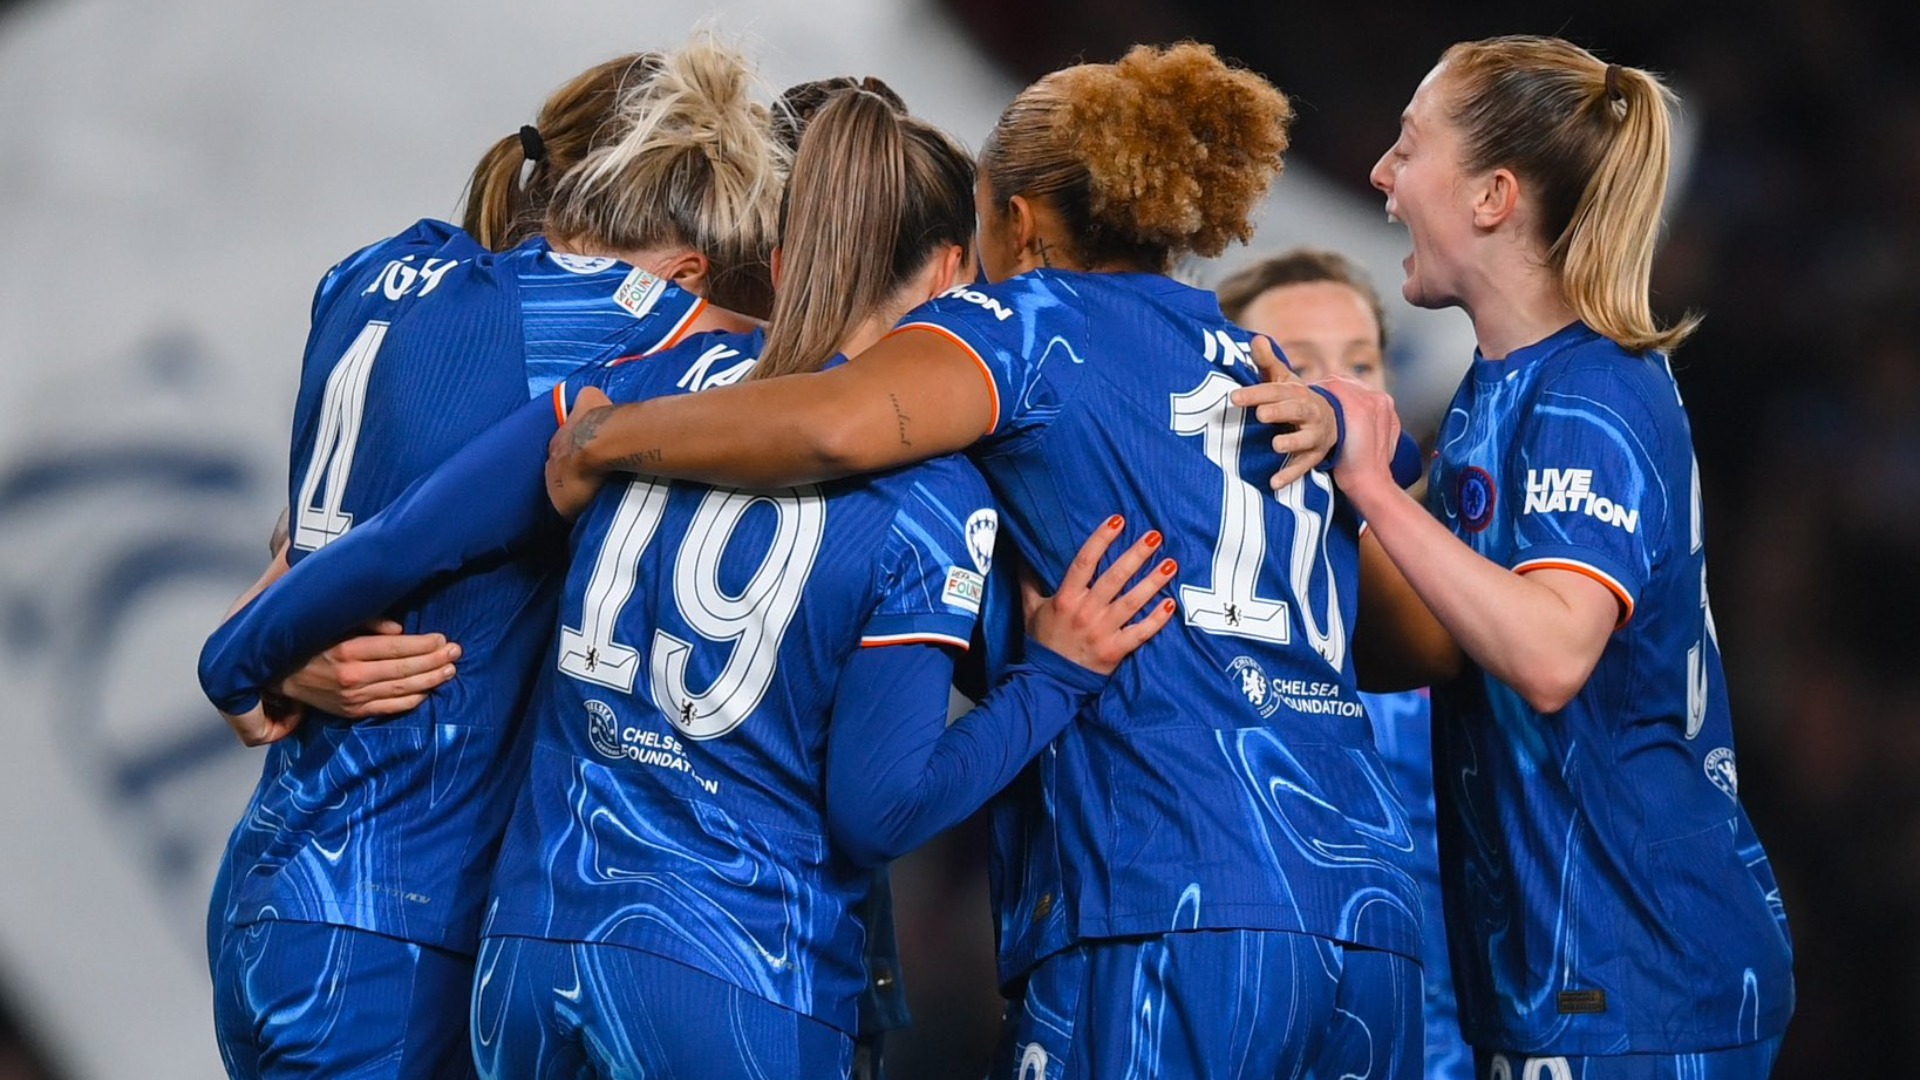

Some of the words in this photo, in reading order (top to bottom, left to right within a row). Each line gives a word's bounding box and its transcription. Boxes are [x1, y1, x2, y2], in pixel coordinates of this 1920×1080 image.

[293, 320, 391, 552] 4
[1527, 468, 1593, 493] LIVE
[1169, 371, 1346, 674] 10
[1523, 490, 1639, 534] NATION
[557, 474, 826, 741] 19
[1272, 678, 1340, 697] CHELSEA
